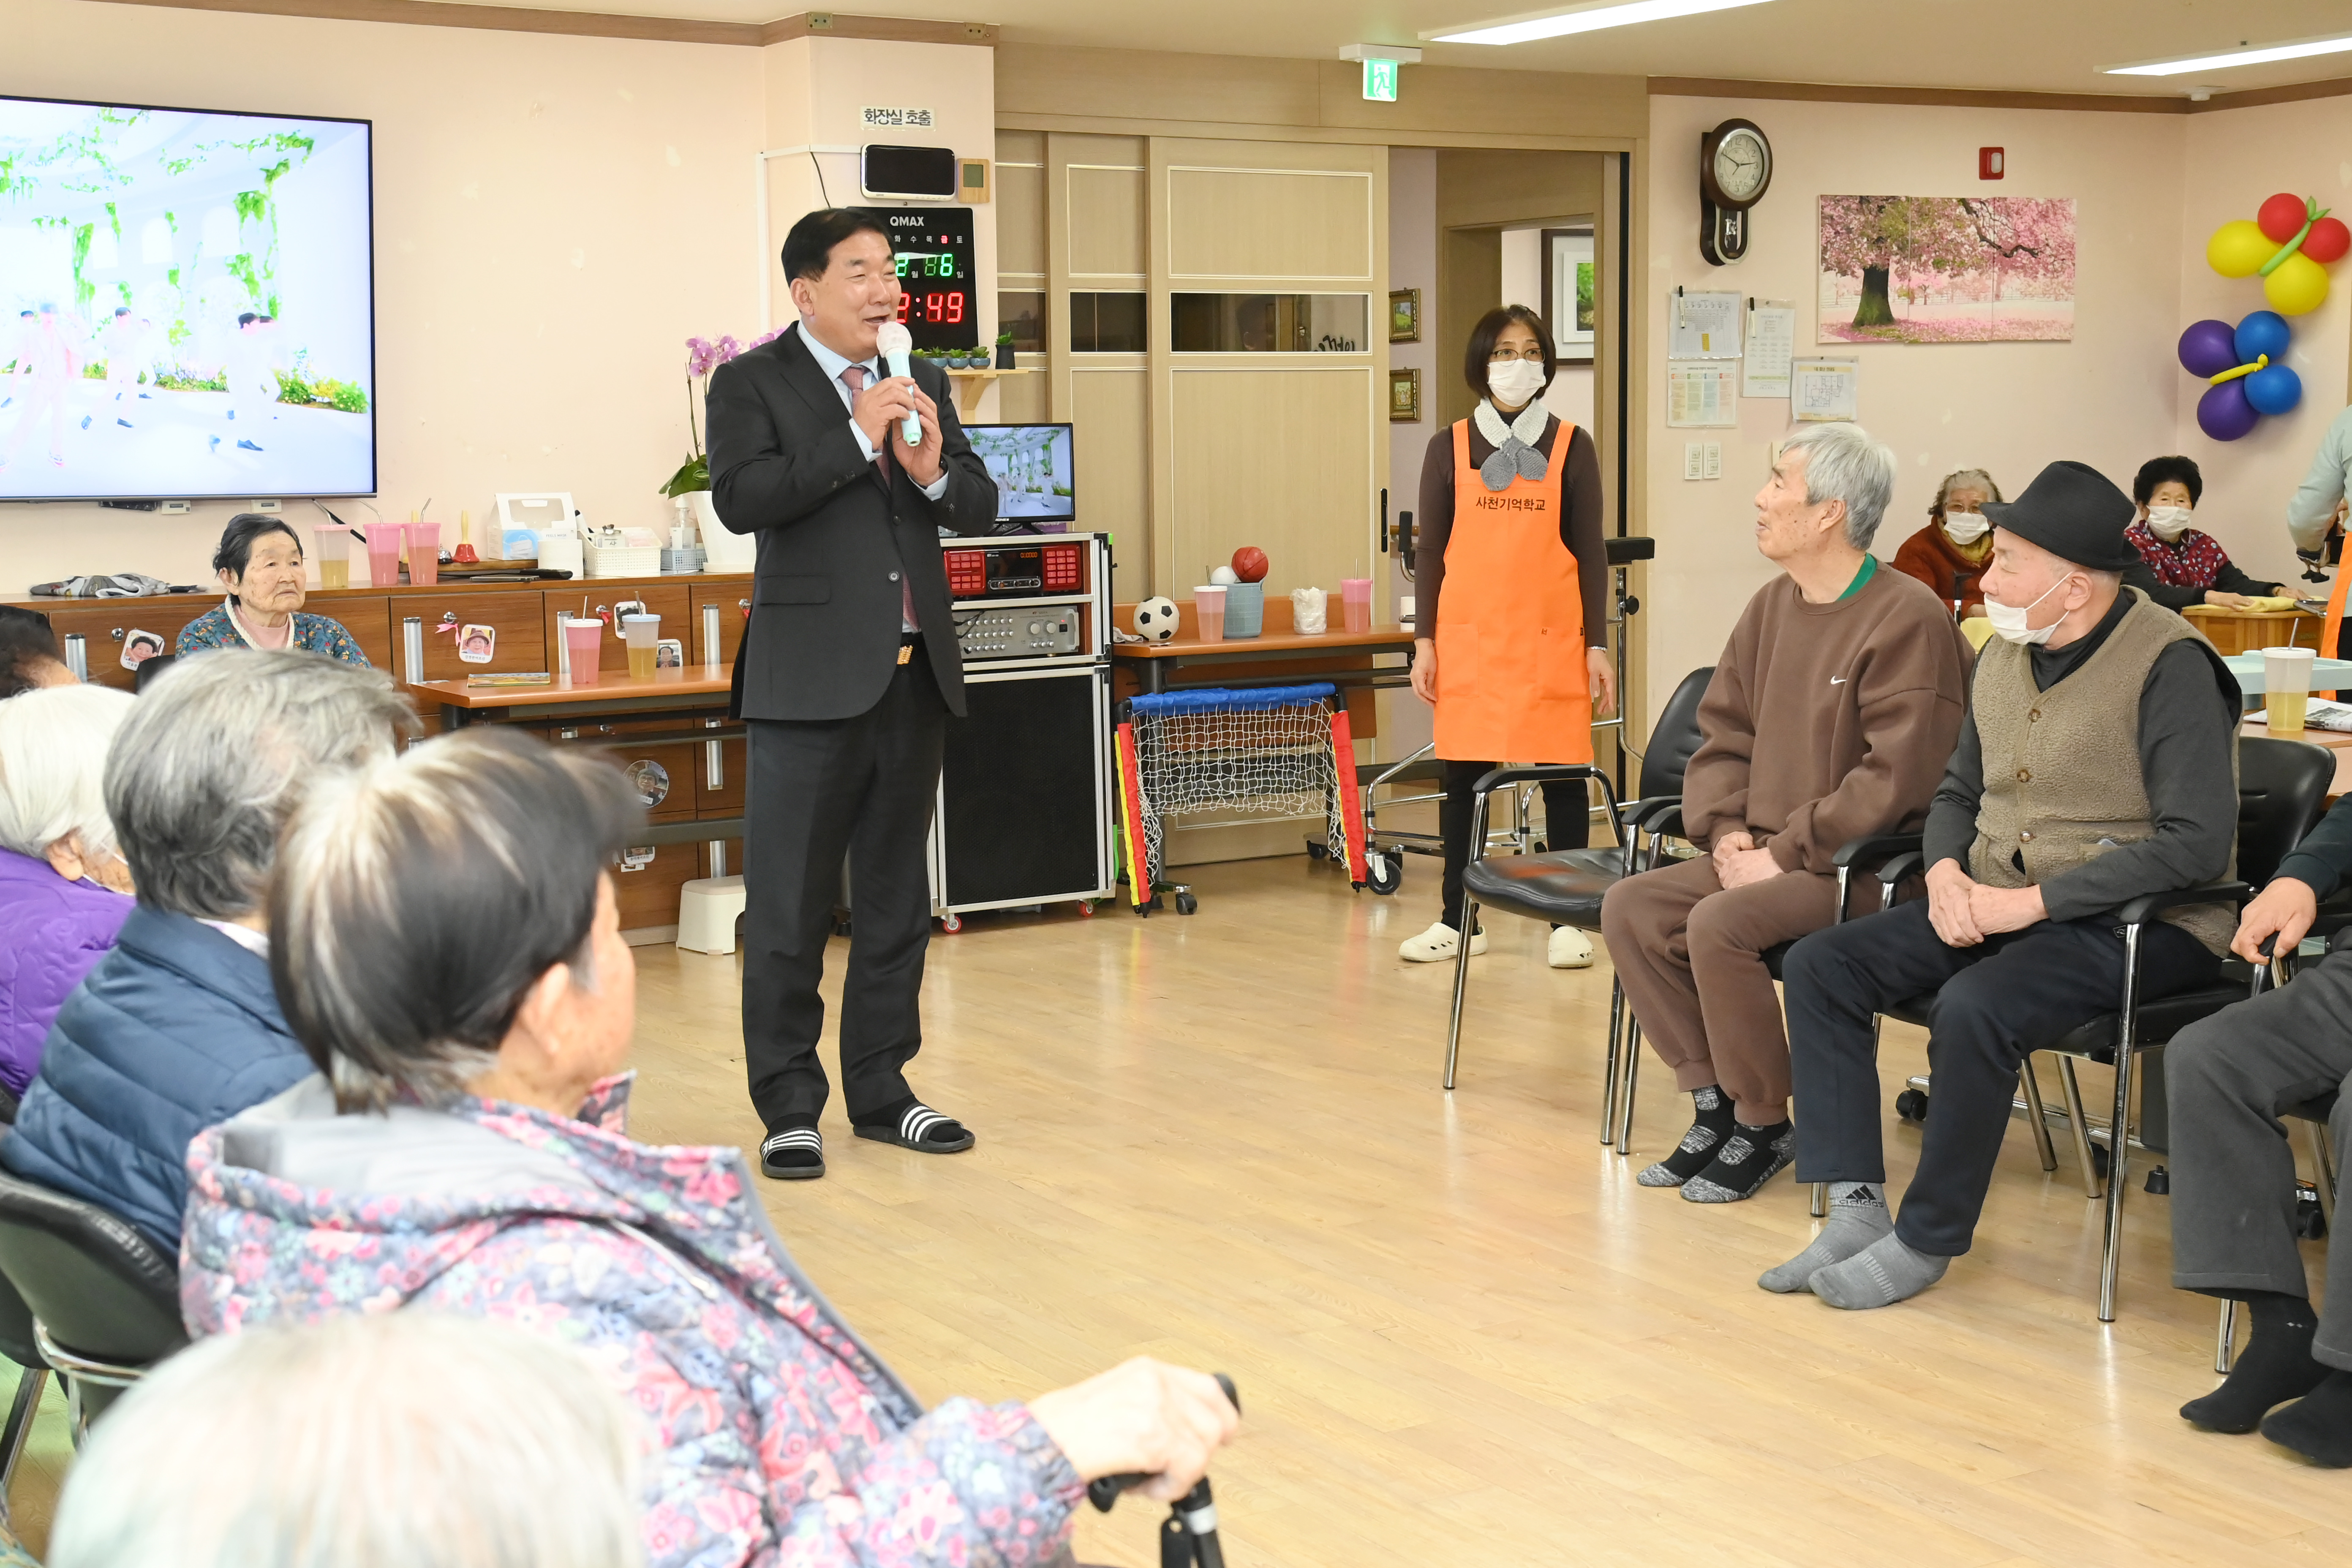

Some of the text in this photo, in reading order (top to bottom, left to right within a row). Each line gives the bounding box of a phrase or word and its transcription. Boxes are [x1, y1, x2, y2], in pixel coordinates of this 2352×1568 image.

[864, 108, 932, 126] 화장실 호출
[890, 216, 925, 226] QMAX
[894, 235, 901, 243] 화
[926, 235, 933, 244] 목
[941, 235, 948, 244] 금
[956, 236, 963, 244] 토
[895, 253, 964, 279] 2 월 6 일
[1475, 496, 1546, 512] 사천기억학교
[1839, 1199, 1884, 1208] adidas
